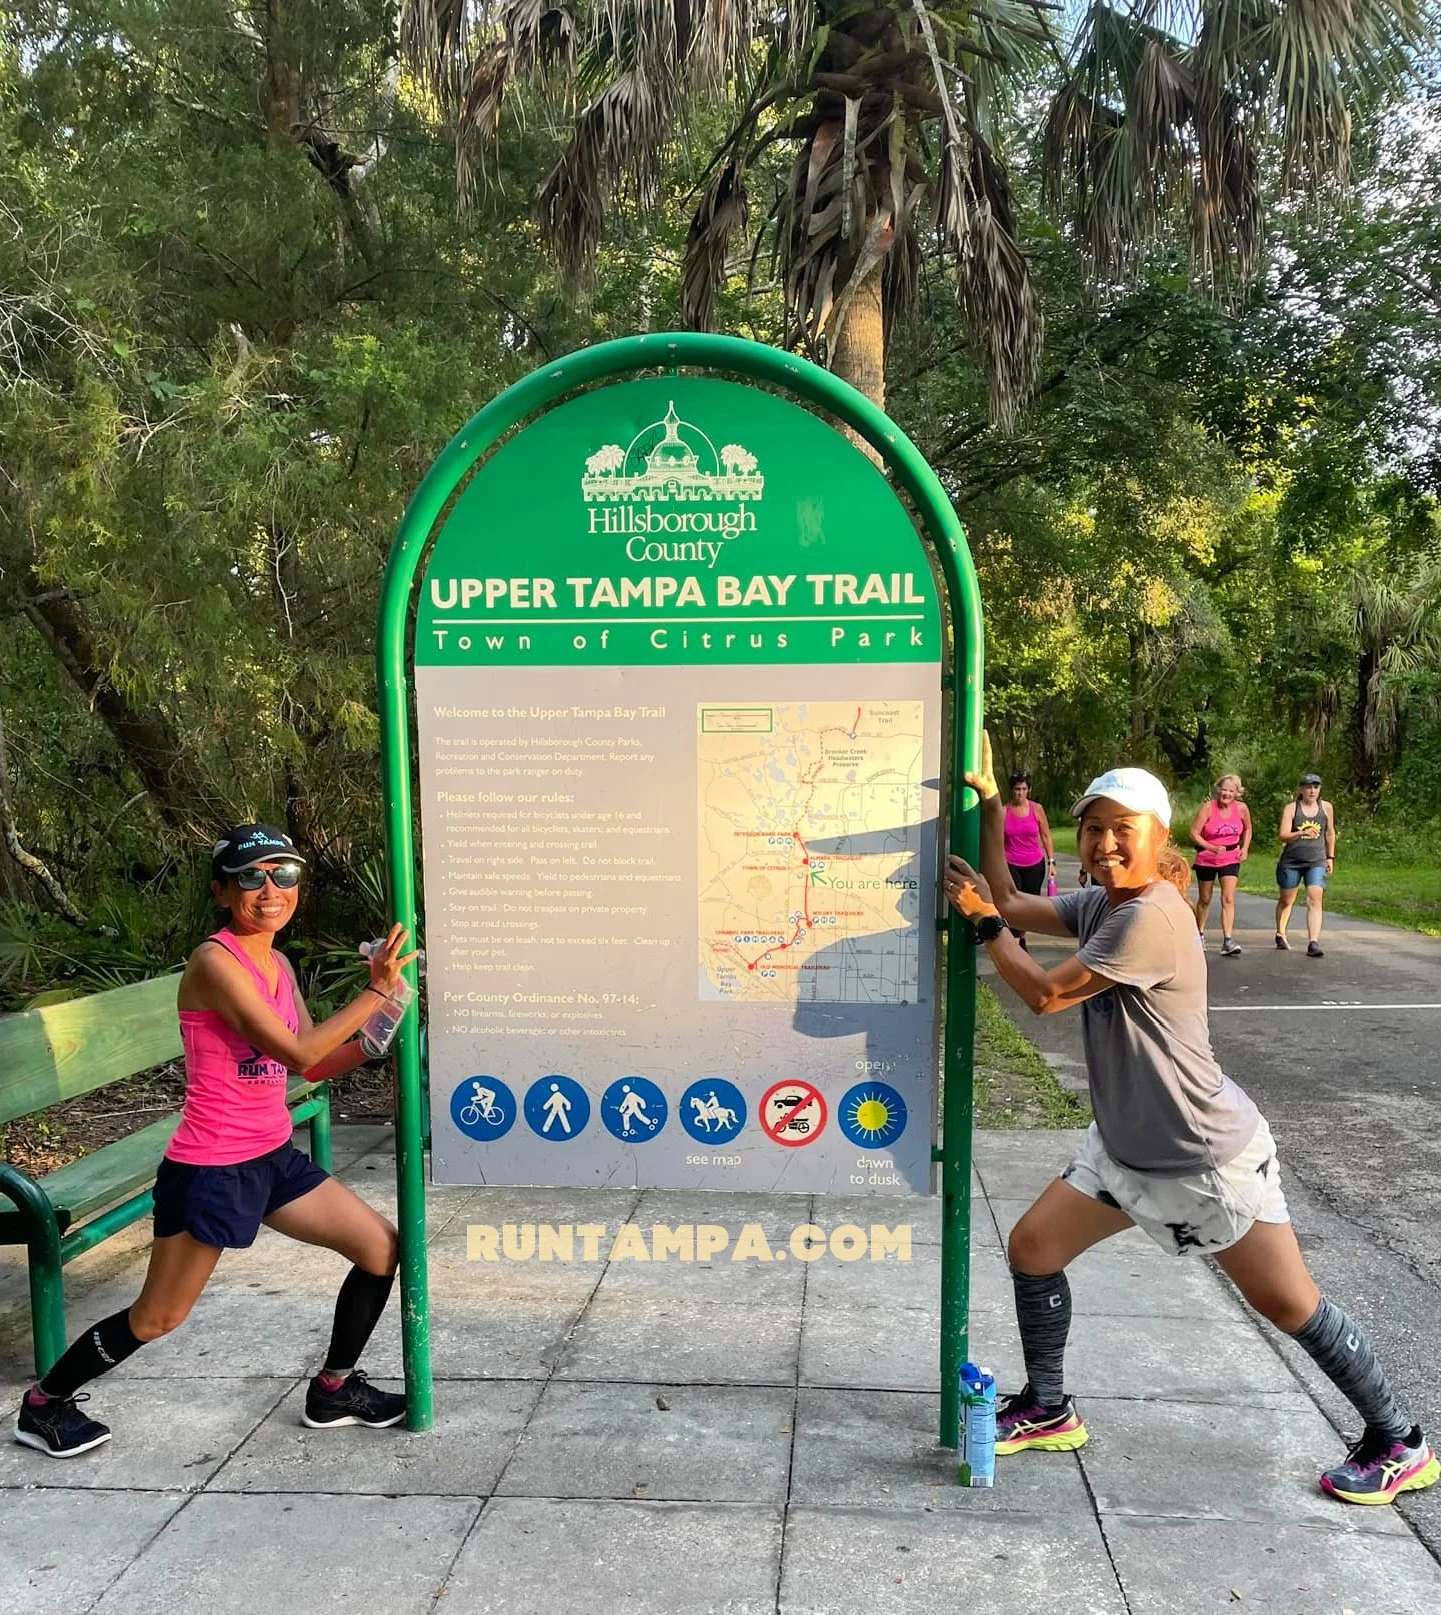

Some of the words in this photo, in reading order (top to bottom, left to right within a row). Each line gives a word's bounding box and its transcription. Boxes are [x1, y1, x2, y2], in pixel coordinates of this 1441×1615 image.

[588, 505, 757, 539] Hillsborough
[625, 536, 724, 568] County
[430, 578, 557, 609] UPPER
[566, 576, 706, 608] TAMPA
[718, 575, 797, 606] BAY
[806, 573, 925, 605] TRAIL
[432, 630, 532, 651] Town
[572, 629, 611, 650] of
[650, 629, 789, 649] Citrus
[831, 627, 924, 648] Park
[434, 706, 489, 718] Welcome
[492, 706, 504, 718] to
[507, 706, 527, 718] the
[530, 706, 568, 720] Upper
[570, 706, 611, 720] Tampa
[614, 706, 636, 720] Bay
[638, 706, 666, 718] Trail
[435, 736, 451, 746] The
[453, 736, 469, 746] trail
[479, 736, 516, 748] operated
[518, 736, 529, 748] by
[531, 736, 583, 748] Hillsborough
[584, 736, 616, 748] County
[435, 751, 479, 760] Recreation
[481, 751, 496, 760] and
[497, 751, 552, 760] Conservation
[609, 751, 638, 762] Report
[640, 753, 656, 762] any
[435, 766, 474, 778] problems
[476, 766, 486, 776] to
[487, 766, 500, 776] the
[502, 766, 521, 778] park
[523, 768, 550, 778] ranger
[551, 768, 563, 776] on
[437, 791, 475, 801] Please
[478, 791, 514, 801] follow
[517, 793, 538, 801] our
[541, 791, 576, 801] rules:
[482, 810, 518, 821] required
[519, 810, 532, 819] for
[533, 810, 570, 821] bicyclists
[571, 810, 596, 819] under
[626, 810, 642, 819] and
[446, 824, 506, 833] recommended
[507, 824, 519, 833] for
[521, 824, 530, 833] all
[606, 824, 621, 834] and
[447, 839, 468, 849] Yield
[469, 839, 492, 849] when
[494, 839, 528, 851] entering
[529, 839, 544, 849] and
[546, 839, 579, 851] crossing
[448, 854, 472, 865] Travel
[473, 857, 485, 865] on
[486, 855, 505, 867] right
[530, 855, 548, 865] Pass
[549, 857, 561, 865] on
[582, 855, 596, 865] Do
[598, 855, 612, 865] not
[613, 855, 636, 865] block
[448, 871, 483, 880] Maintain
[484, 871, 500, 880] safe
[536, 871, 557, 880] Yield
[559, 871, 568, 880] to
[569, 871, 616, 883] pedestrians
[618, 871, 633, 881] and
[828, 876, 854, 890] You
[858, 880, 880, 890] are
[885, 877, 918, 890] here
[448, 887, 468, 896] Give
[500, 887, 532, 898] warning
[534, 887, 561, 897] before
[449, 902, 466, 914] Stay
[503, 903, 516, 913] Do
[518, 903, 532, 913] not
[534, 903, 567, 915] trespass
[568, 905, 580, 913] on
[581, 903, 609, 916] private
[450, 919, 470, 930] Stop
[481, 919, 500, 928] road
[450, 934, 468, 943] Pets
[469, 934, 489, 943] must
[491, 934, 502, 944] be
[540, 935, 554, 944] not
[556, 935, 566, 944] to
[567, 935, 596, 945] exceed
[598, 935, 609, 945] six
[633, 935, 658, 946] Clean
[659, 938, 670, 948] up
[451, 947, 469, 956] after
[471, 949, 489, 958] your
[491, 947, 506, 959] pet.
[452, 962, 472, 974] Help
[473, 962, 492, 974] keep
[494, 962, 511, 972] trail
[443, 991, 464, 1004] Per
[467, 992, 509, 1006] County
[512, 992, 574, 1004] Ordinance
[577, 992, 599, 1004] No.
[602, 993, 640, 1004] 97-14:
[454, 1008, 470, 1018] NO
[550, 1011, 560, 1019] or
[452, 1024, 468, 1034] NO
[547, 1027, 556, 1035] or
[238, 1064, 269, 1076] RUN
[686, 1155, 709, 1165] see
[712, 1155, 742, 1168] map
[856, 1156, 894, 1168] dawn
[849, 1174, 864, 1185] to
[868, 1173, 901, 1186] dusk
